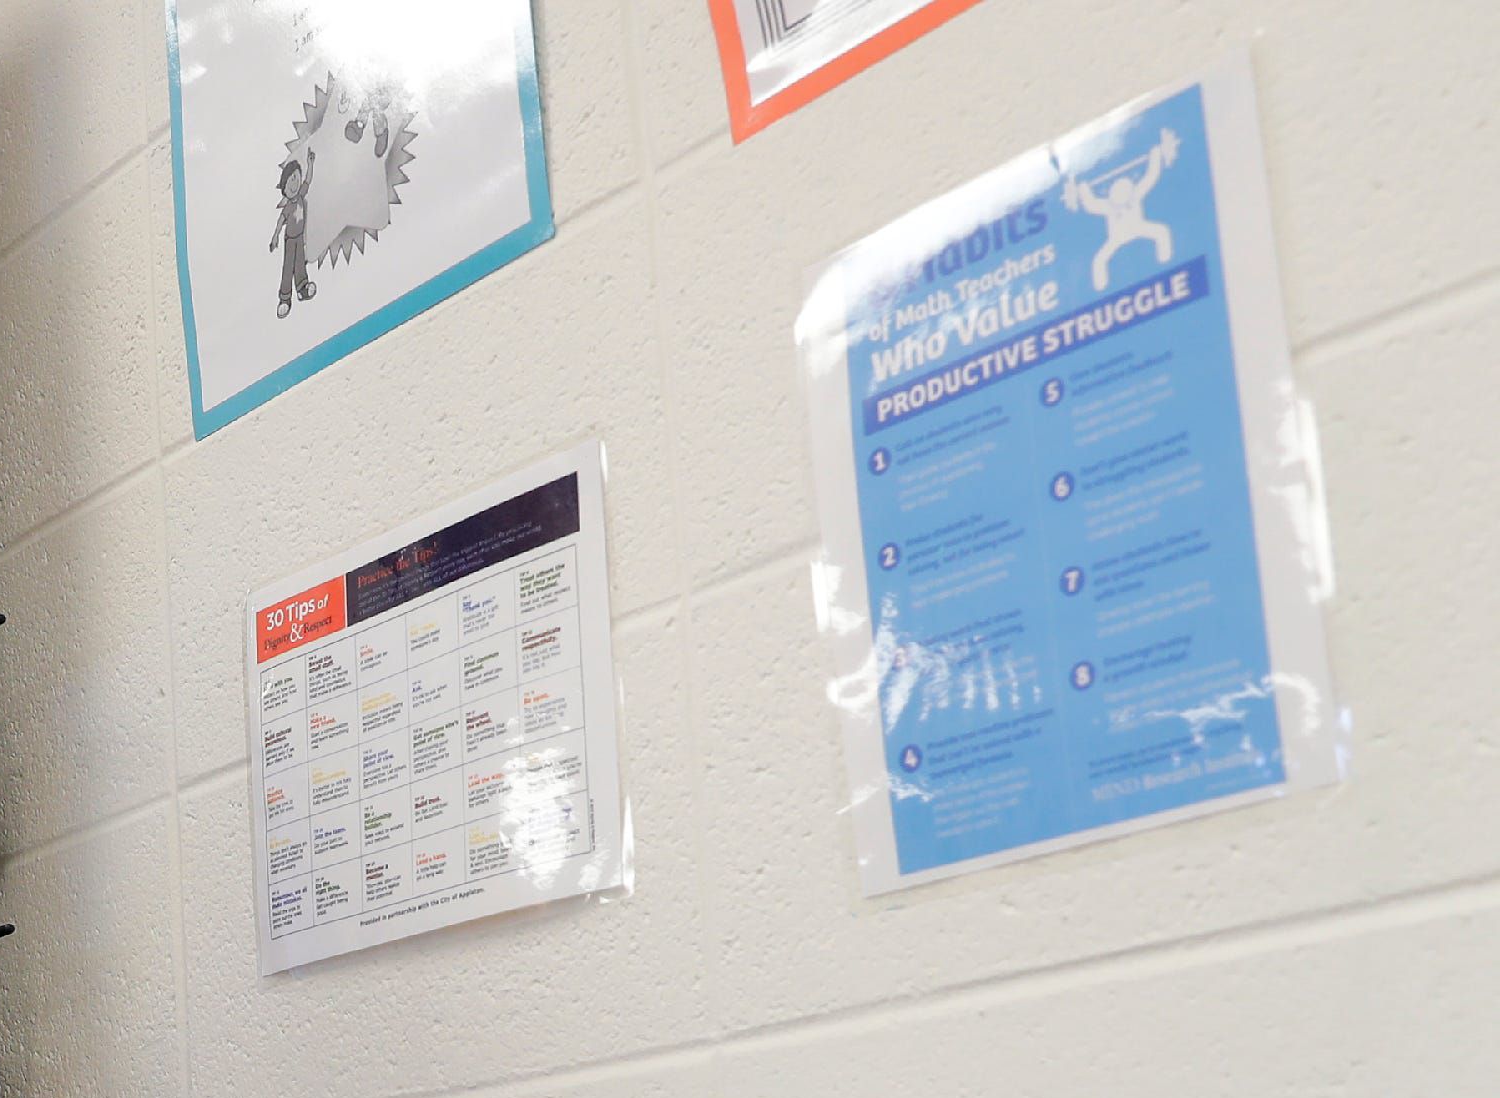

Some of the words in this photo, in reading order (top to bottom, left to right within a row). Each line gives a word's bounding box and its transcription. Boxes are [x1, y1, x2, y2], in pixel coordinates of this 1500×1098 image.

[868, 313, 890, 344] of
[896, 290, 952, 331] Math
[955, 243, 1056, 300] Teachers
[871, 327, 948, 382] Who
[955, 281, 1061, 346] Value
[876, 336, 1040, 424] PRODUCTIVE
[1043, 270, 1191, 354] STRUGGLE
[1044, 380, 1060, 402] 5
[873, 451, 886, 471] 1
[1054, 475, 1070, 497] 6
[883, 546, 896, 567] 2
[357, 560, 395, 589] Practice
[1065, 571, 1080, 592] 7
[265, 608, 284, 631] 30
[286, 598, 315, 622] Tips
[318, 593, 329, 608] of
[264, 633, 292, 651] Dignity
[290, 621, 304, 643] &
[303, 615, 333, 633] Respect
[1076, 664, 1091, 686] 8
[905, 747, 919, 768] 4
[360, 915, 381, 927] Provided
[388, 906, 417, 922] partnership
[417, 902, 430, 911] with
[430, 899, 440, 908] the
[440, 896, 451, 906] City
